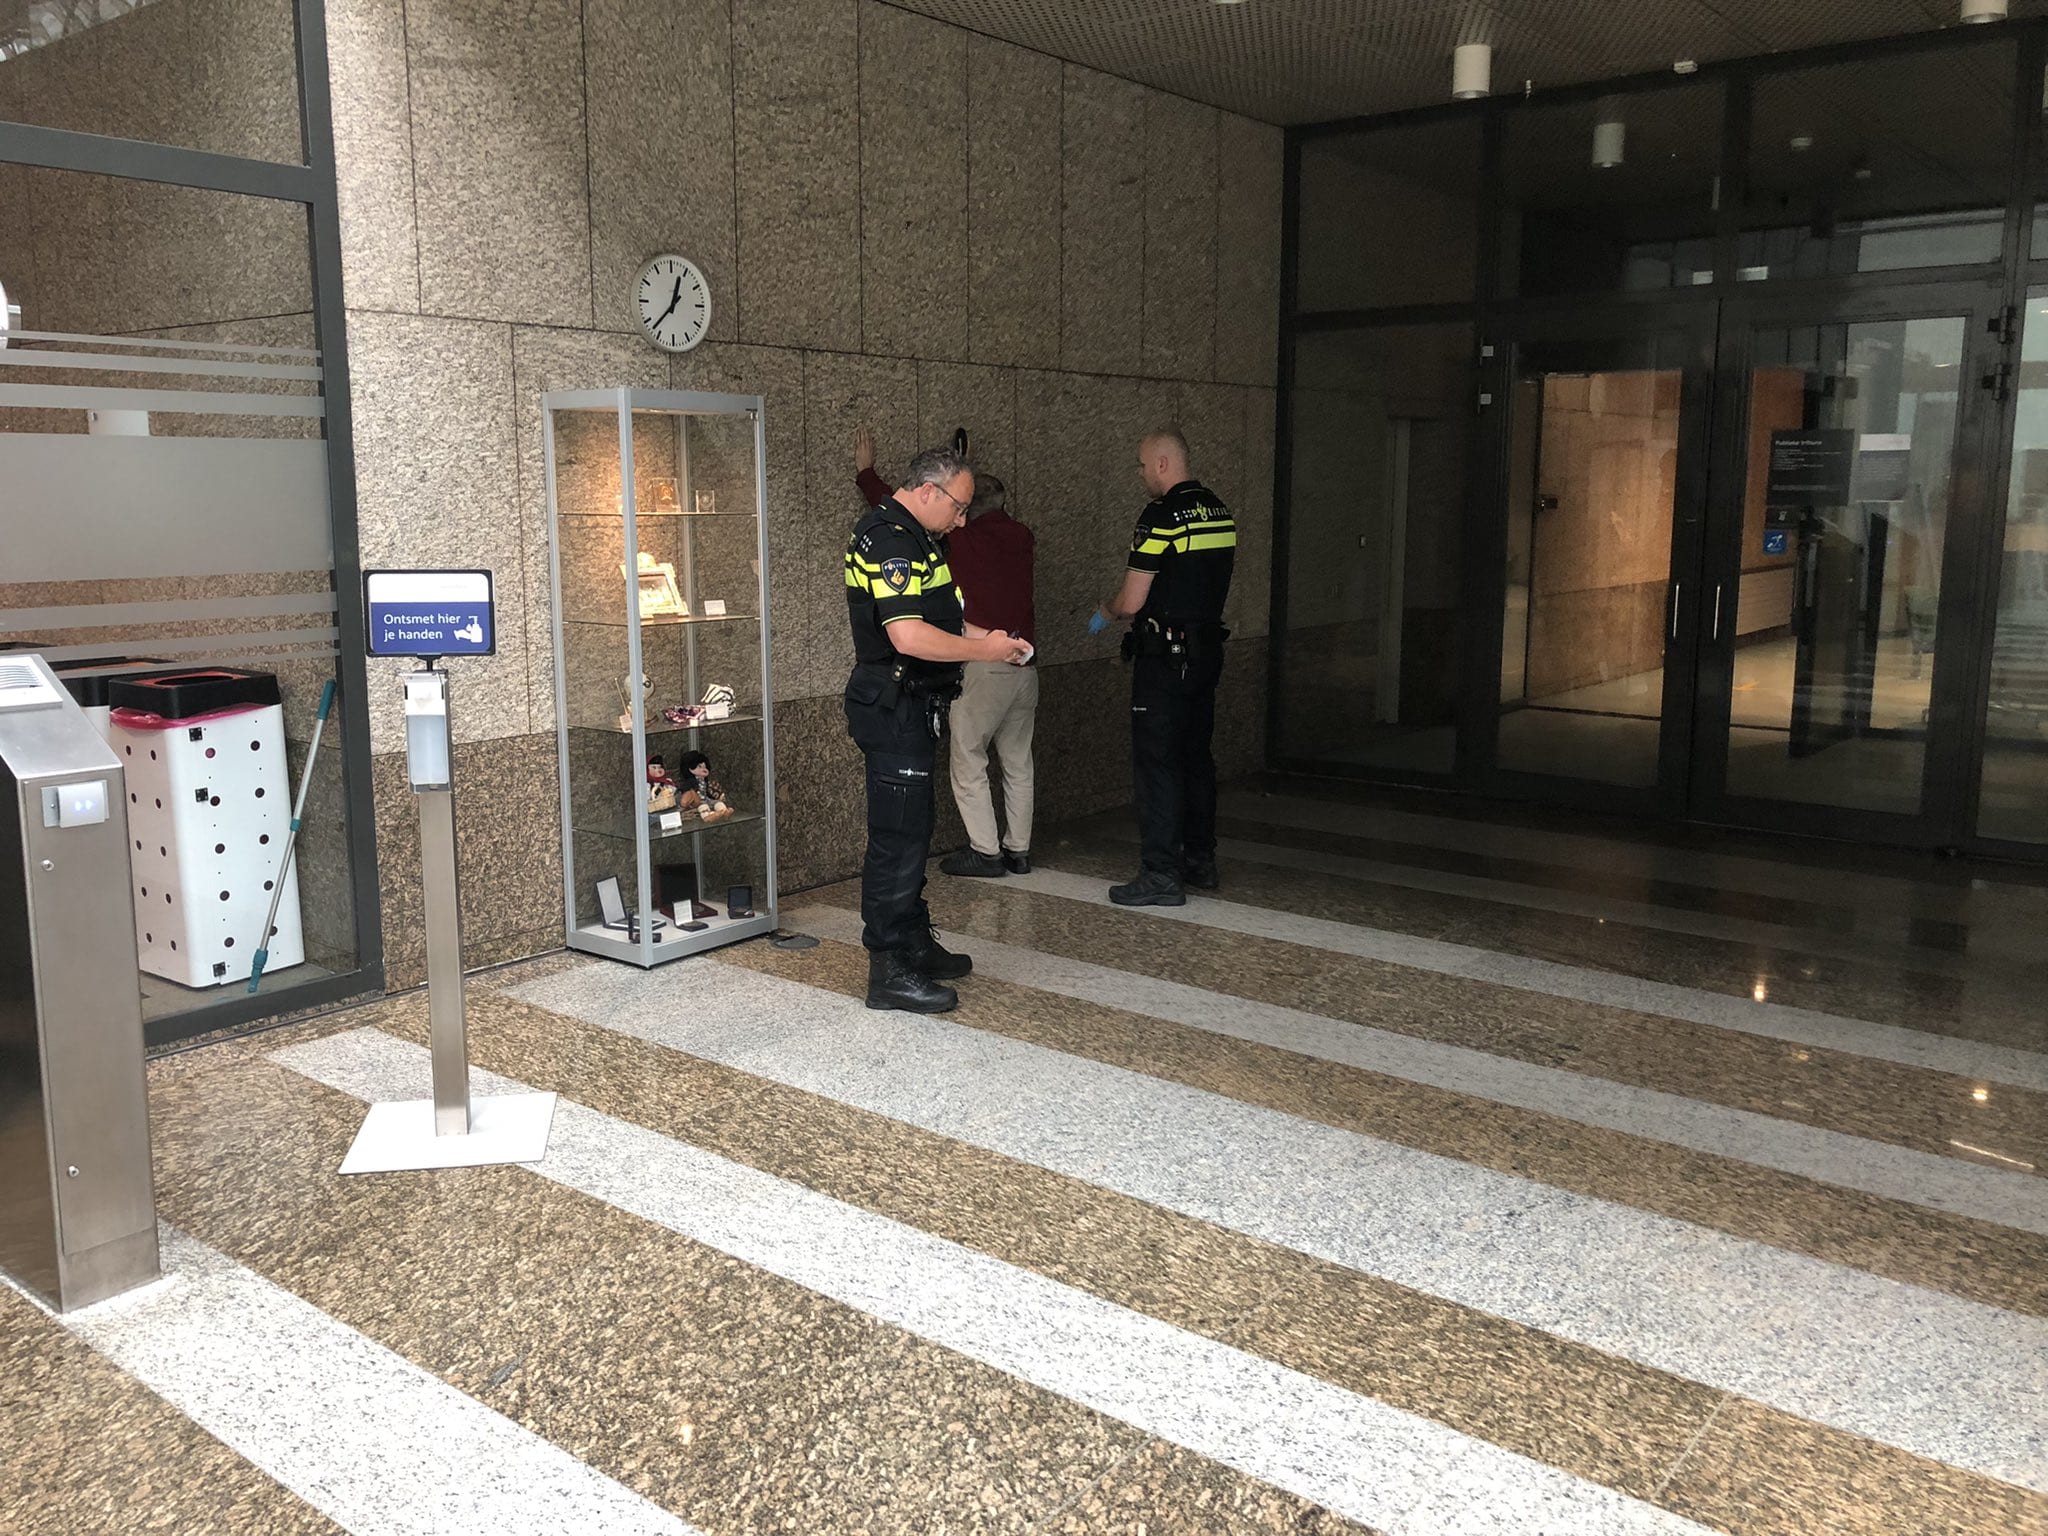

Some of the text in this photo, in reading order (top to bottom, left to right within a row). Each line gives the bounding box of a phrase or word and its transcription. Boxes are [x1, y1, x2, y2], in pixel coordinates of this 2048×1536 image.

[383, 613, 461, 625] Ontsmet hier
[383, 628, 443, 643] je handen
